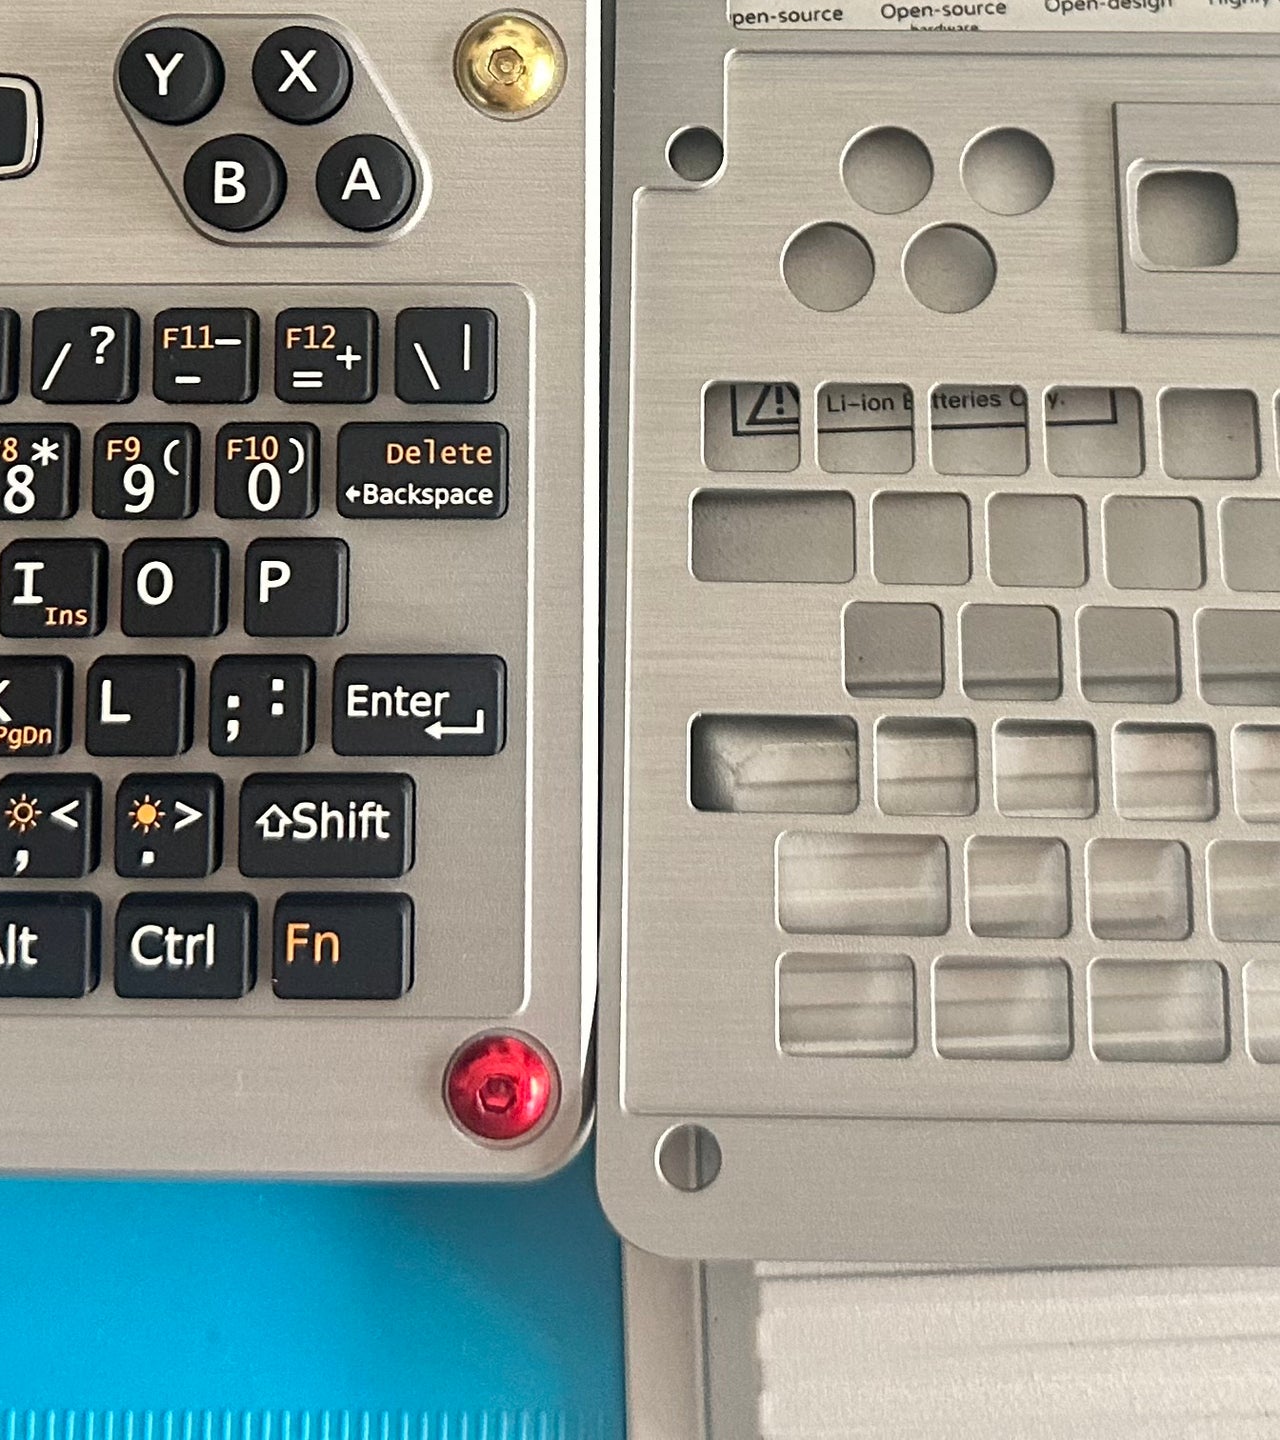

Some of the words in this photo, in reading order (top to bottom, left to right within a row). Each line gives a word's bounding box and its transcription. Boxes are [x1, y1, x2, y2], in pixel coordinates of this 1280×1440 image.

[730, 6, 843, 26] pen-source
[880, 0, 1007, 22] Open-source
[145, 52, 184, 96] Y
[278, 49, 317, 92] X
[213, 161, 247, 204] B
[341, 157, 381, 200] A
[89, 325, 116, 364] ?
[162, 324, 214, 349] F11
[285, 324, 336, 349] F12
[827, 394, 894, 413] Li-ion
[107, 436, 141, 461] F9
[163, 439, 180, 475] (
[227, 435, 279, 461] F10
[288, 438, 305, 475] )
[386, 438, 492, 465] Delete
[3, 464, 35, 514] 8
[123, 463, 155, 513] 9
[247, 462, 281, 511] 0
[362, 483, 493, 509] Backspace
[12, 562, 44, 604] I
[136, 561, 174, 605] O
[258, 561, 291, 603] P
[45, 607, 88, 625] Ins
[101, 679, 131, 722] L
[346, 684, 450, 718] Enter
[291, 801, 391, 840] Shift
[130, 923, 215, 967] Ctrl
[285, 922, 340, 964] Fn
